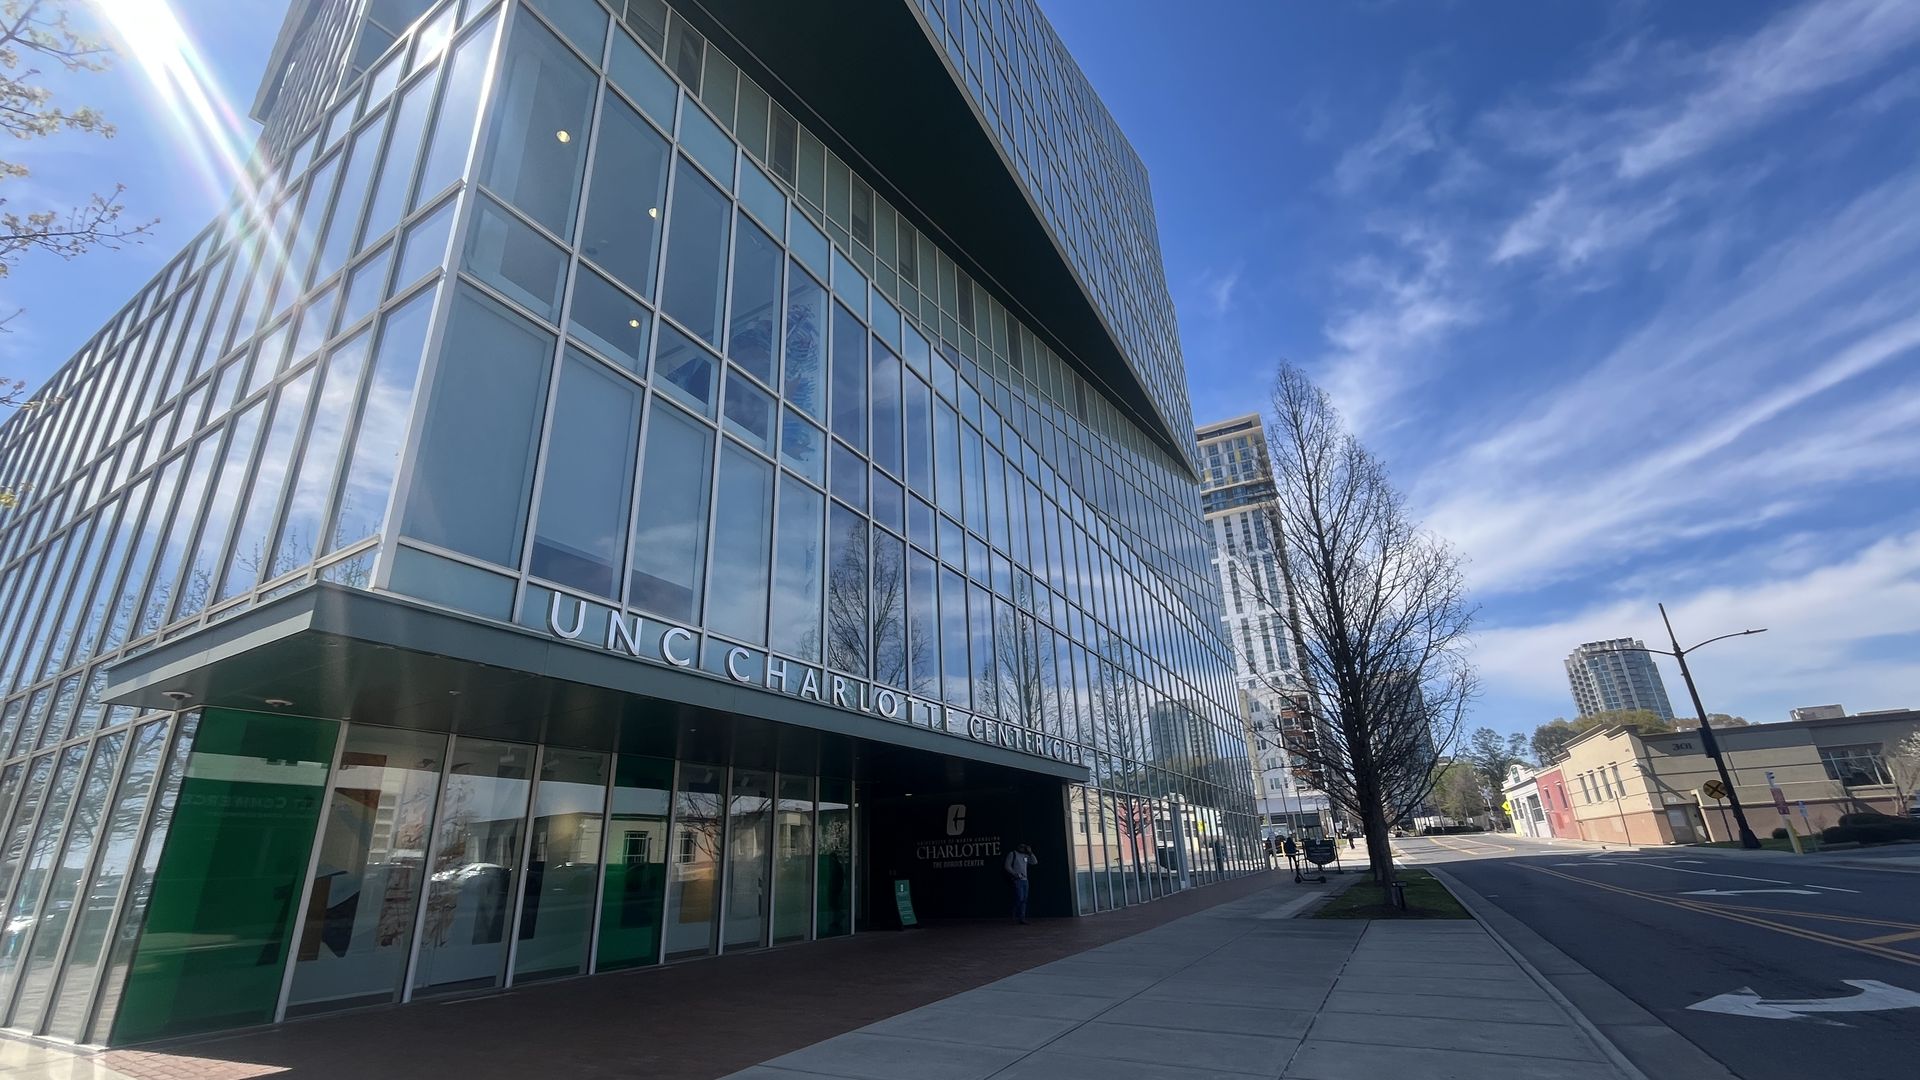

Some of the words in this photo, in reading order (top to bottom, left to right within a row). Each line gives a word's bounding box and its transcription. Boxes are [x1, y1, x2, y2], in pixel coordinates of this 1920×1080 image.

[547, 591, 691, 667] UNC
[724, 646, 959, 734] CHARLOTTE
[967, 715, 1045, 755] CENTER
[1051, 739, 1085, 765] CITY
[917, 841, 1001, 859] CHARLOTTE
